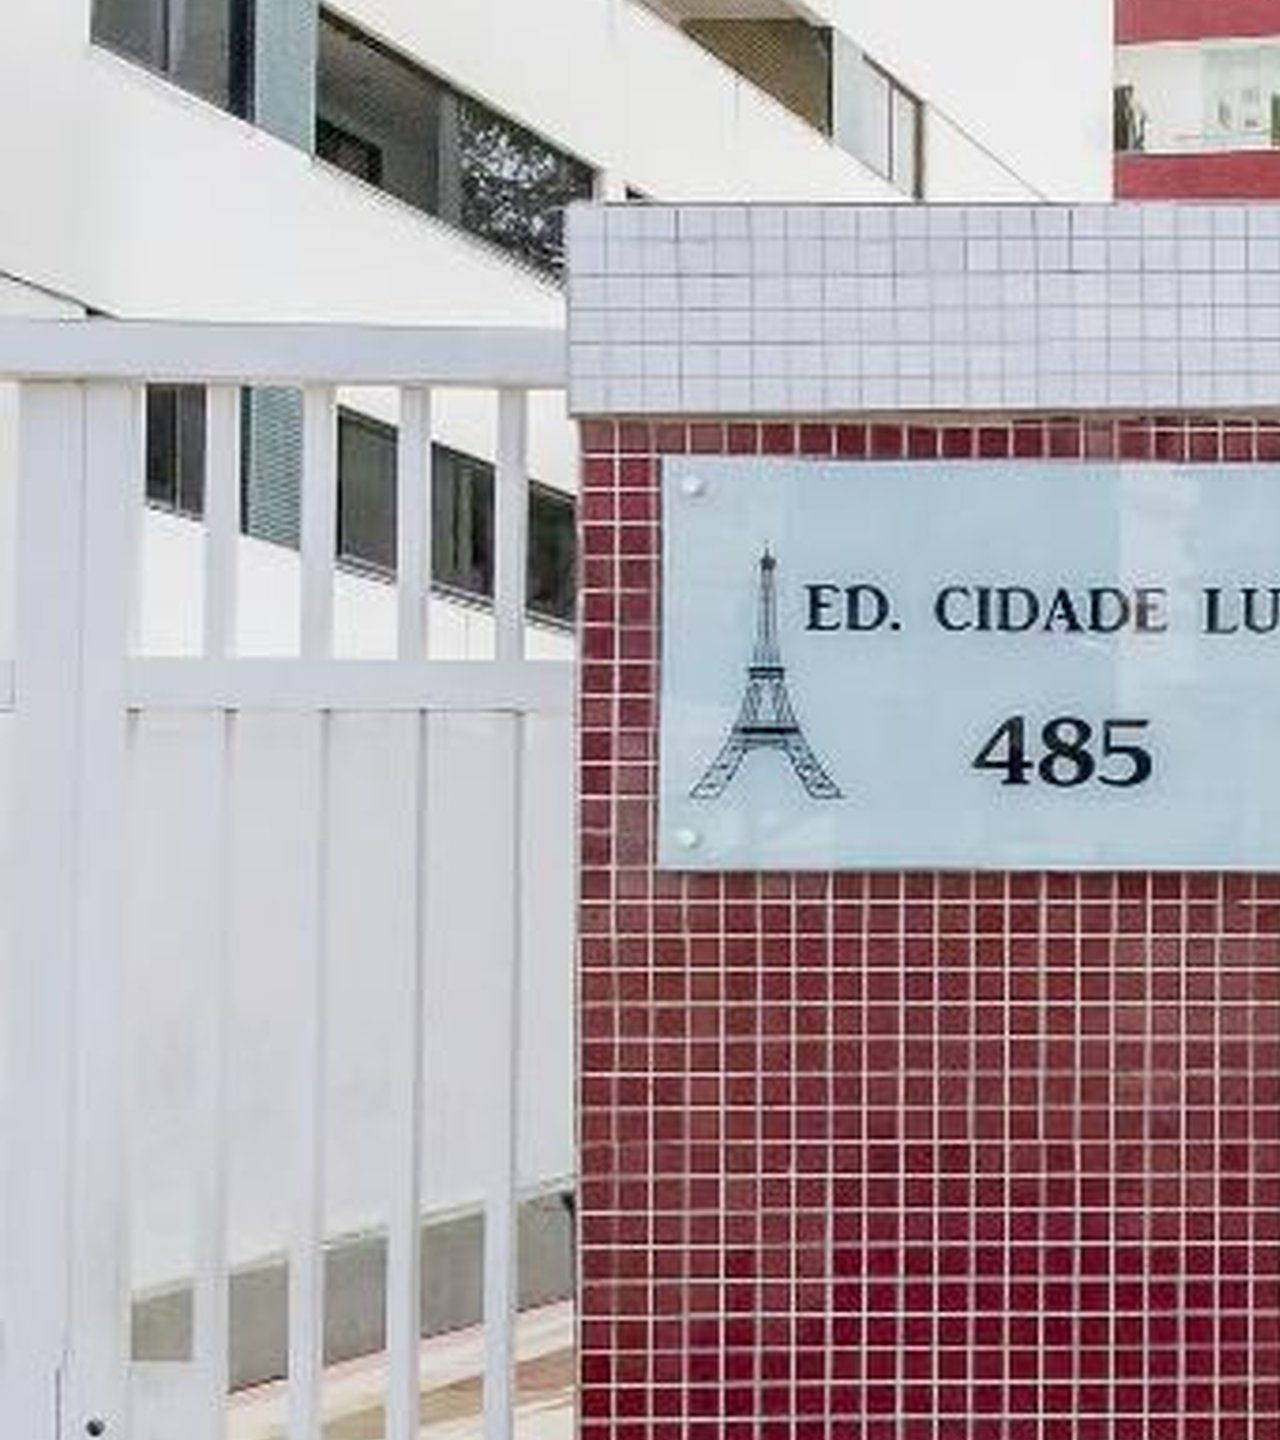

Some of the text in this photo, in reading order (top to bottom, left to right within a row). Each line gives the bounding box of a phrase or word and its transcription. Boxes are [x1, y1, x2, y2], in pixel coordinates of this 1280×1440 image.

[803, 582, 901, 633] ED.
[933, 584, 1168, 635] CIDADE
[970, 713, 1154, 789] 485
